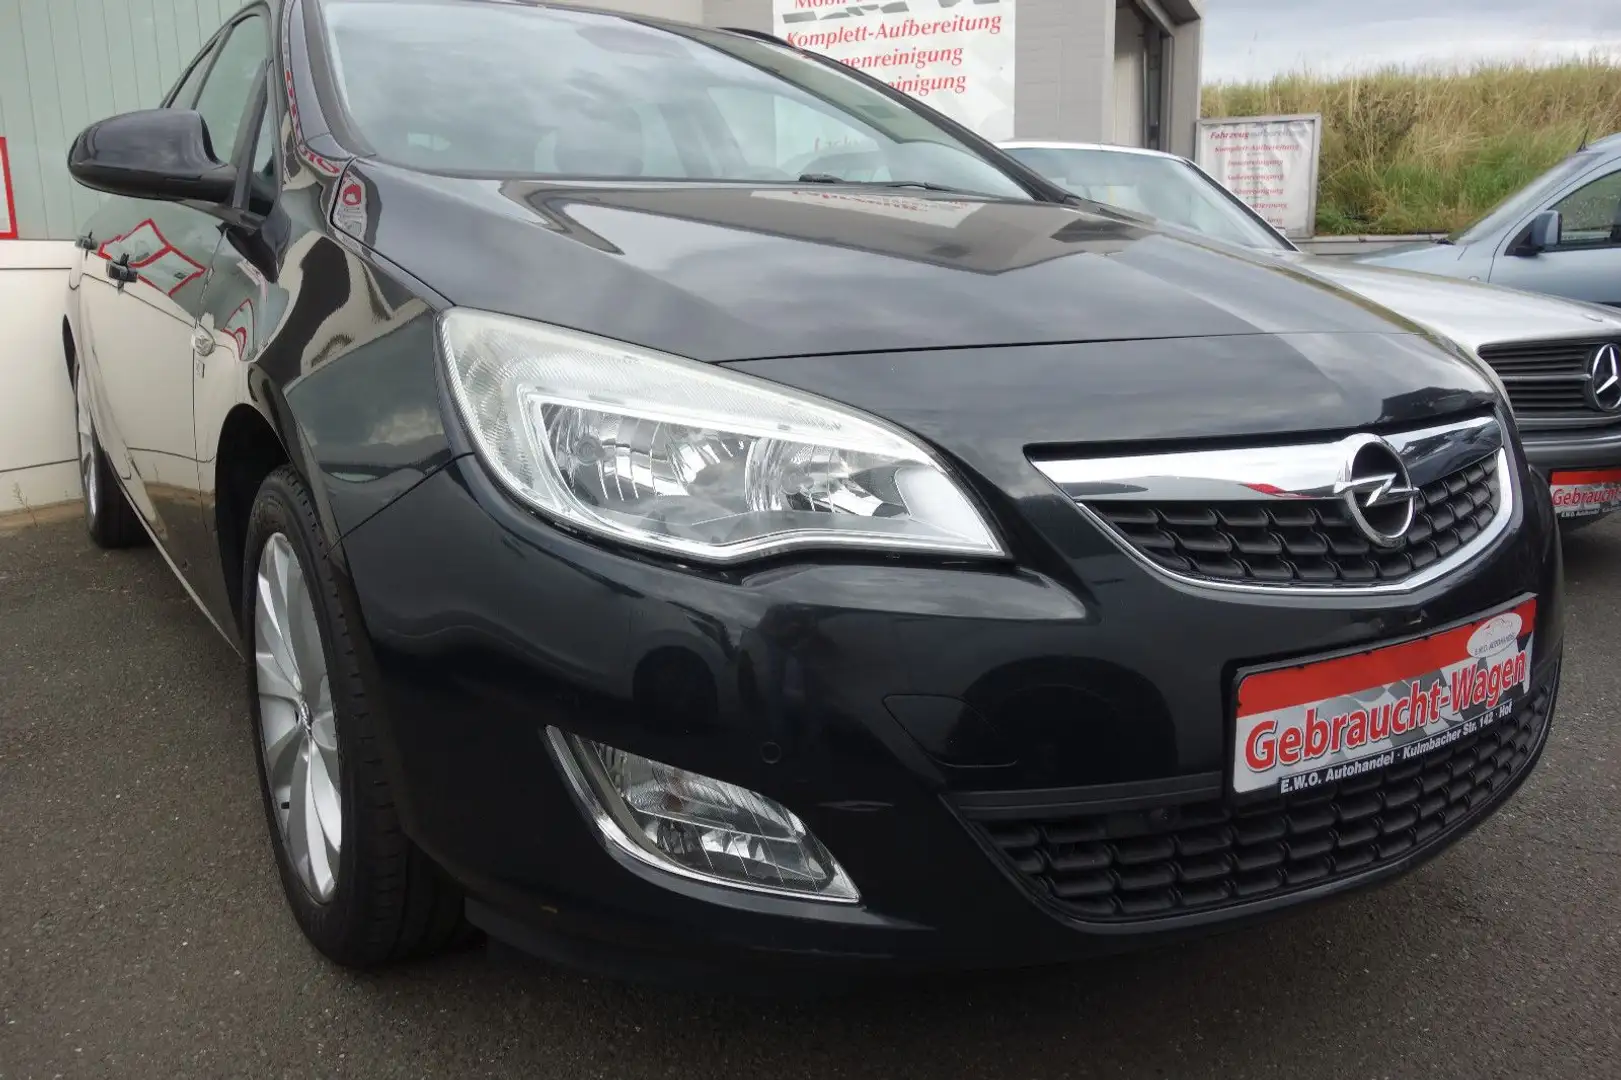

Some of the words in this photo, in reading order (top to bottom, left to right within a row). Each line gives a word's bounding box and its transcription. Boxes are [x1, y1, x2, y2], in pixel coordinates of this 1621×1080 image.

[787, 14, 1001, 49] Komplett-Aufbereitung
[839, 46, 964, 69] nenreinigung
[888, 74, 966, 96] einigung
[1244, 650, 1526, 771] Gebraucht-Wagen
[1280, 771, 1322, 794] E.W.O.
[1325, 750, 1395, 782] Autohandel
[1402, 728, 1462, 759] Kulmbacher
[1463, 721, 1478, 735] Str.
[1480, 711, 1494, 728] 142
[1499, 700, 1513, 718] Hof
